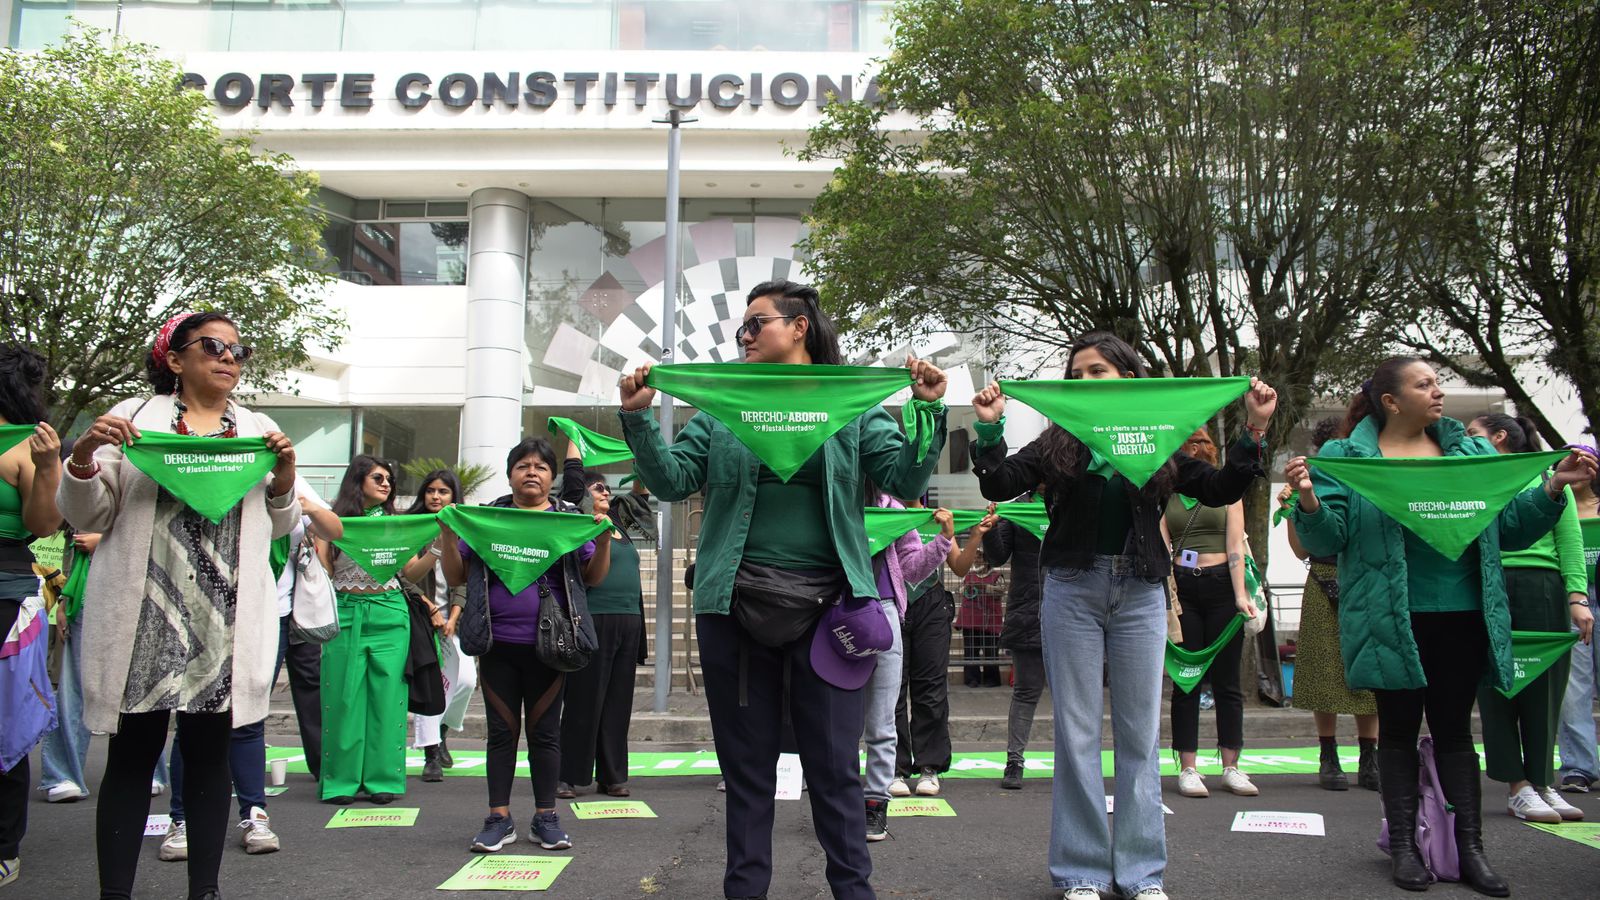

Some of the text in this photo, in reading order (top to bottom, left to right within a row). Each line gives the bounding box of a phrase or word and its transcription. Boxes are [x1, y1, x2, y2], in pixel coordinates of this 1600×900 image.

[741, 411, 783, 422] DERECHO
[788, 412, 828, 422] ABORTO
[1117, 432, 1148, 444] JUSTA
[1112, 443, 1156, 455] LIBERTAD
[164, 453, 209, 464] DERECHO
[214, 452, 256, 464] ABORTO
[186, 465, 236, 473] #JustaLibertad
[1408, 501, 1446, 512] DERECHO
[1450, 500, 1486, 511] ABORTO
[491, 543, 520, 554] DERECHO
[522, 547, 549, 558] ABORTO
